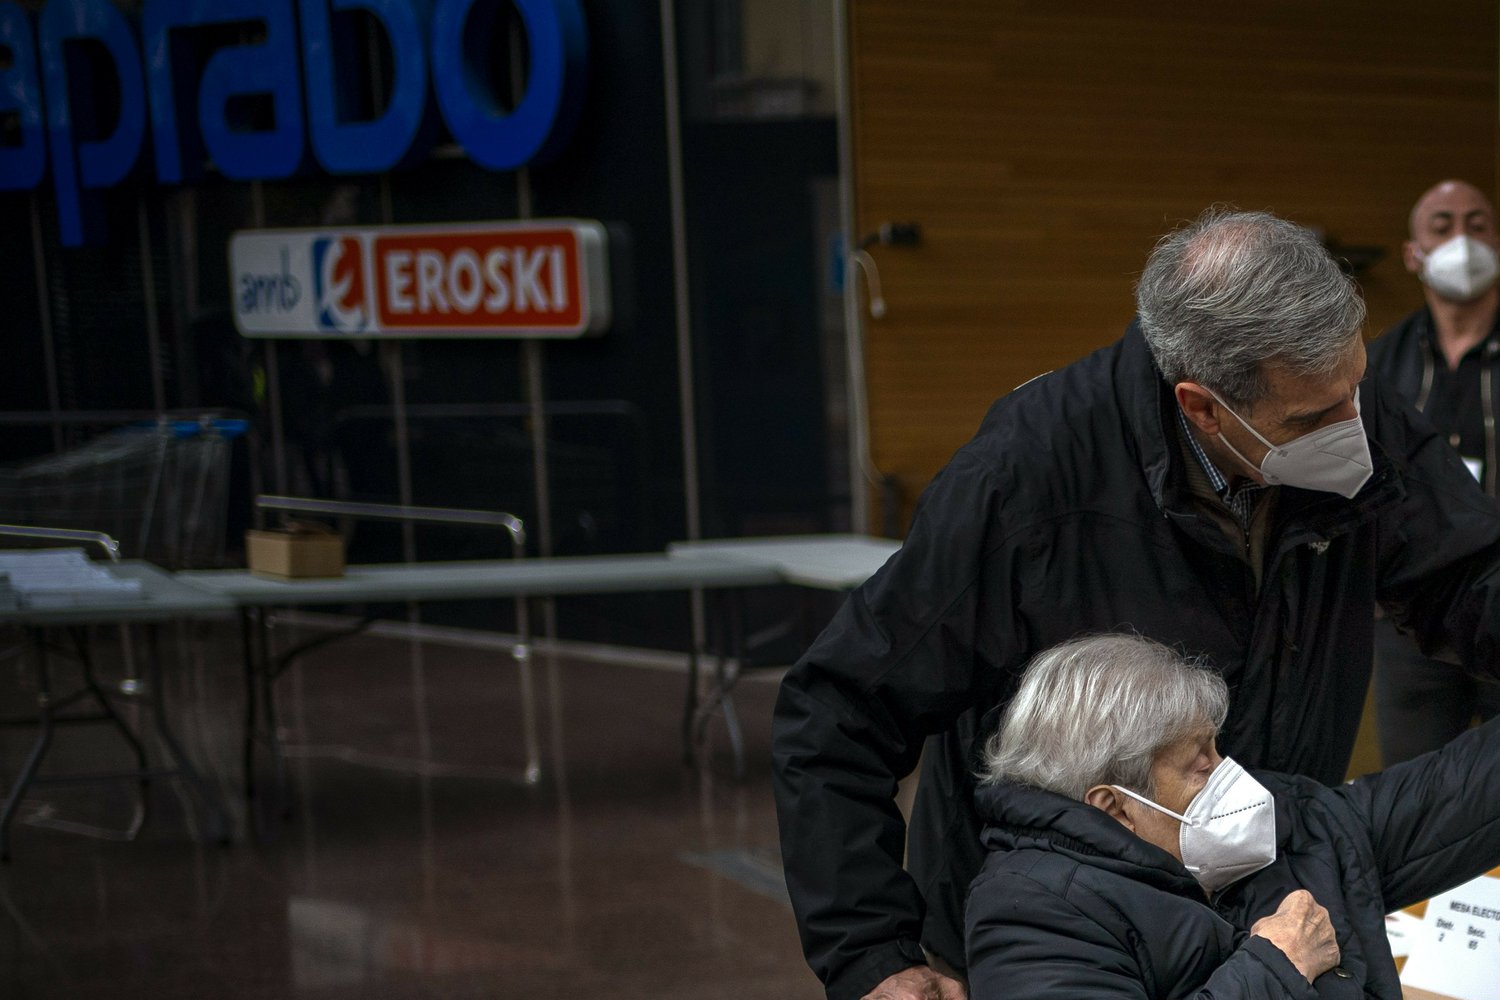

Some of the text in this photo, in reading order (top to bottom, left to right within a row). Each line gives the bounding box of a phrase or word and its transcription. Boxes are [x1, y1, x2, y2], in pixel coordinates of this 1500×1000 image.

[239, 245, 570, 316] amb EROSKI
[1450, 901, 1470, 912] MESA
